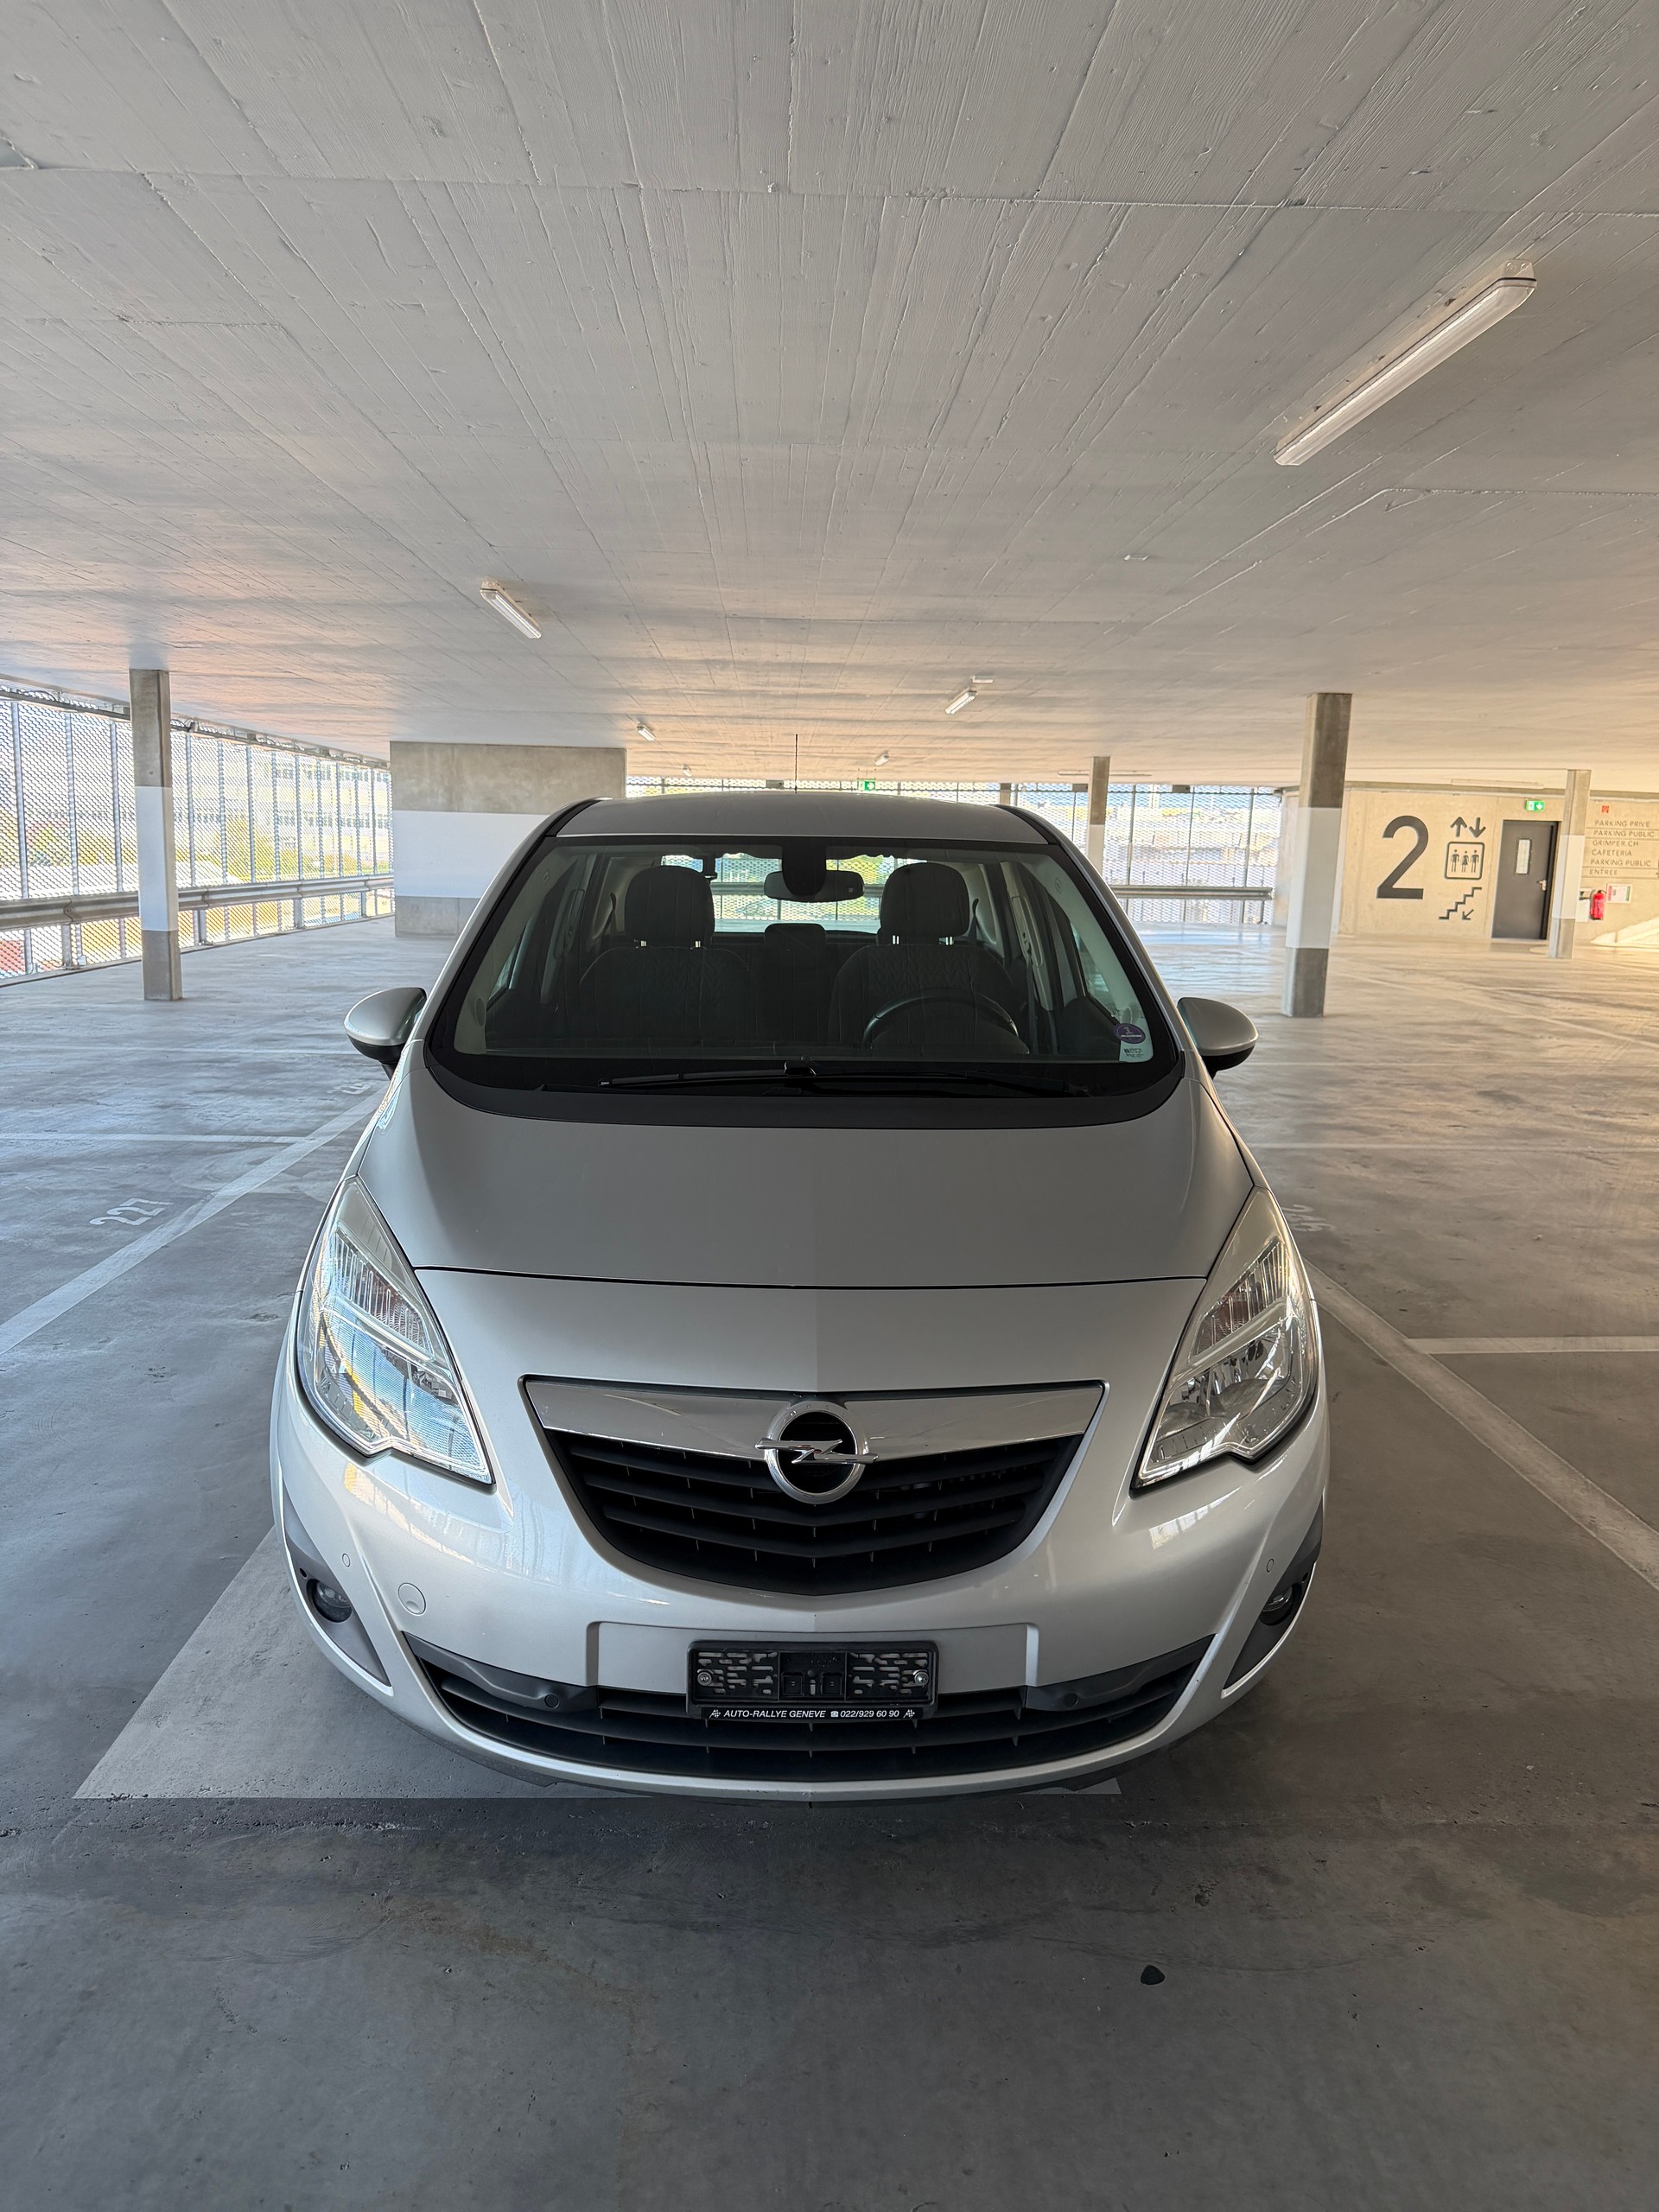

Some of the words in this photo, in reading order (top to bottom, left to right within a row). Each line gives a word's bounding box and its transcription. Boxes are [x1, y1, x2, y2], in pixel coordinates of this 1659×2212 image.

[1594, 819, 1627, 828] PARKING
[1376, 815, 1429, 899] 2
[89, 1198, 175, 1225] 227
